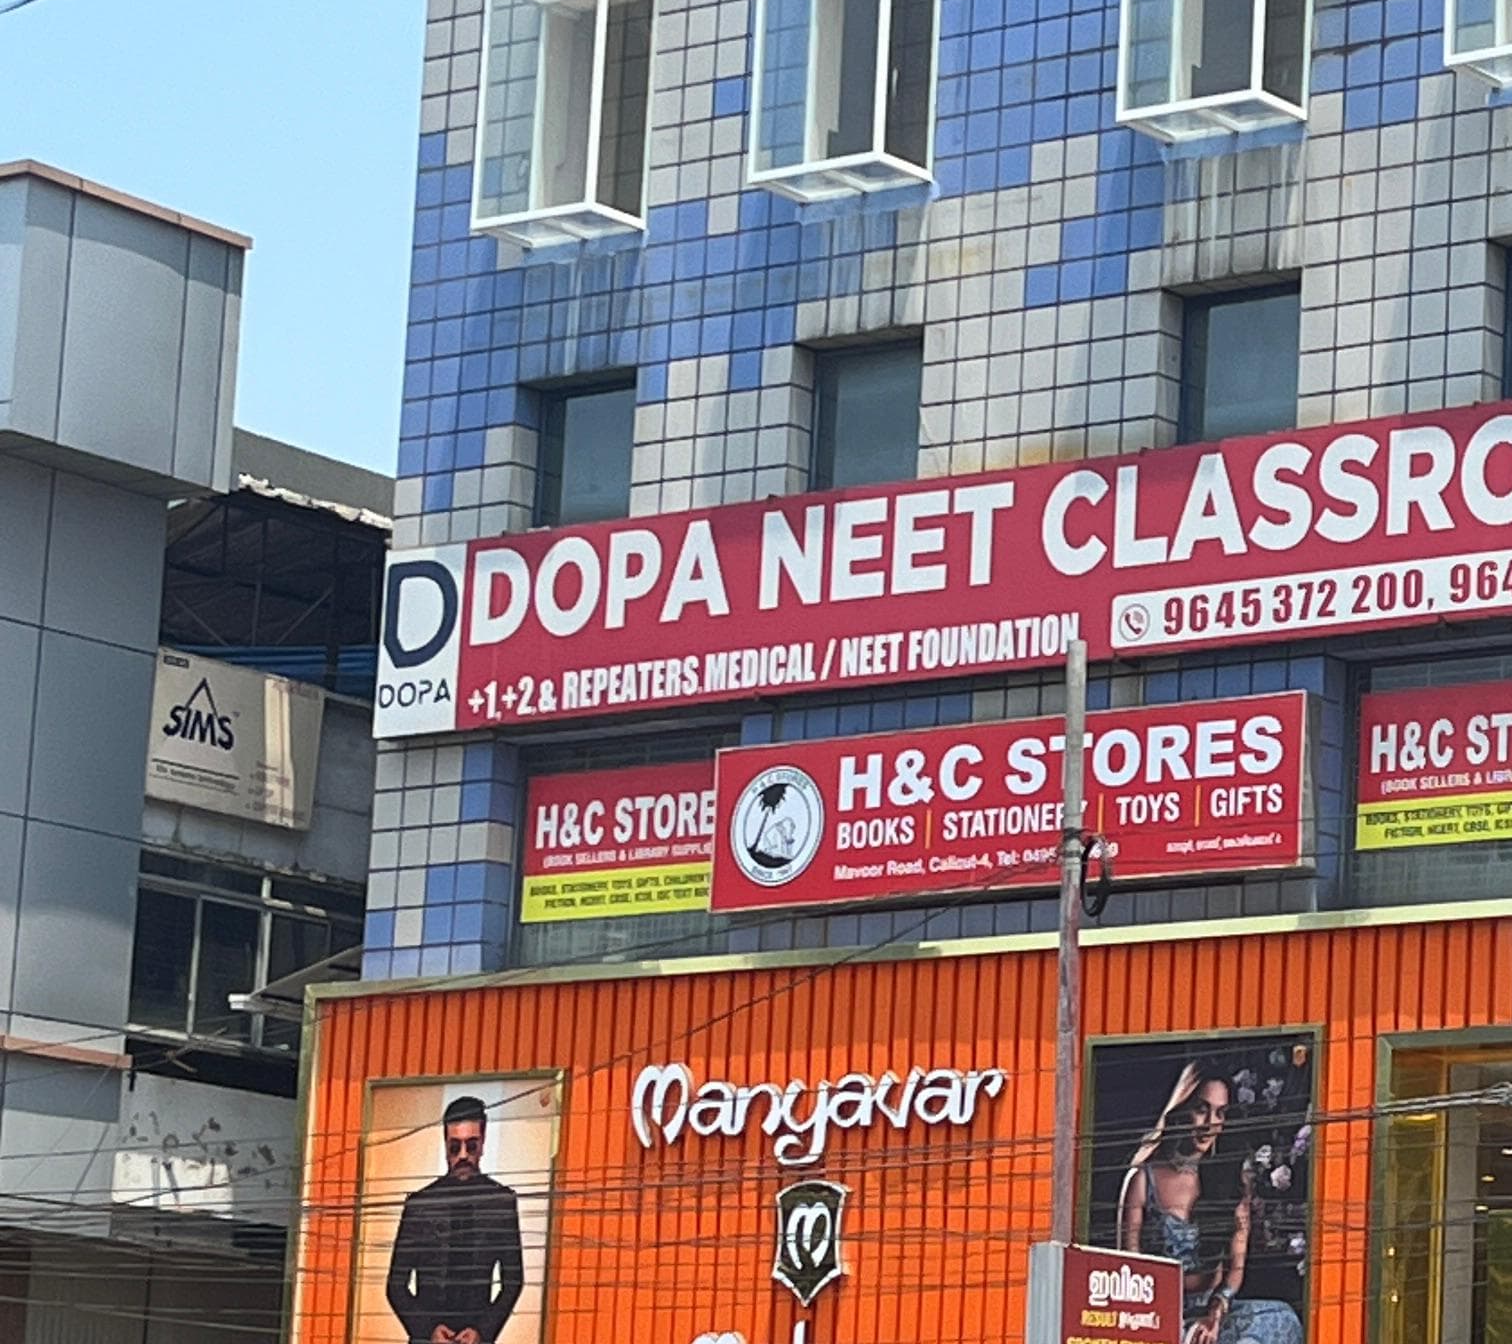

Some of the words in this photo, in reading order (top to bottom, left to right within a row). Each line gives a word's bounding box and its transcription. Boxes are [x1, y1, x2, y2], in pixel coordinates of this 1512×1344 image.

[469, 520, 730, 645] DOPA
[759, 482, 1014, 609] NEET
[1164, 590, 1261, 635] 9645
[1273, 580, 1336, 621] 372
[1352, 569, 1435, 613] 200,
[840, 633, 903, 677] NEET
[907, 612, 1079, 671] FOUNDATION
[379, 677, 451, 709] DOPA
[163, 705, 234, 750] SIMS
[1371, 719, 1455, 774] H&C
[838, 745, 983, 812] H&C
[536, 802, 605, 849] H&C
[613, 790, 714, 843] STORE
[837, 816, 915, 850] BOOKS
[943, 800, 1087, 840] STATIONER
[1116, 792, 1180, 826] TOYS
[1210, 784, 1283, 817] GIFTS
[632, 1063, 1008, 1165] Manyavar
